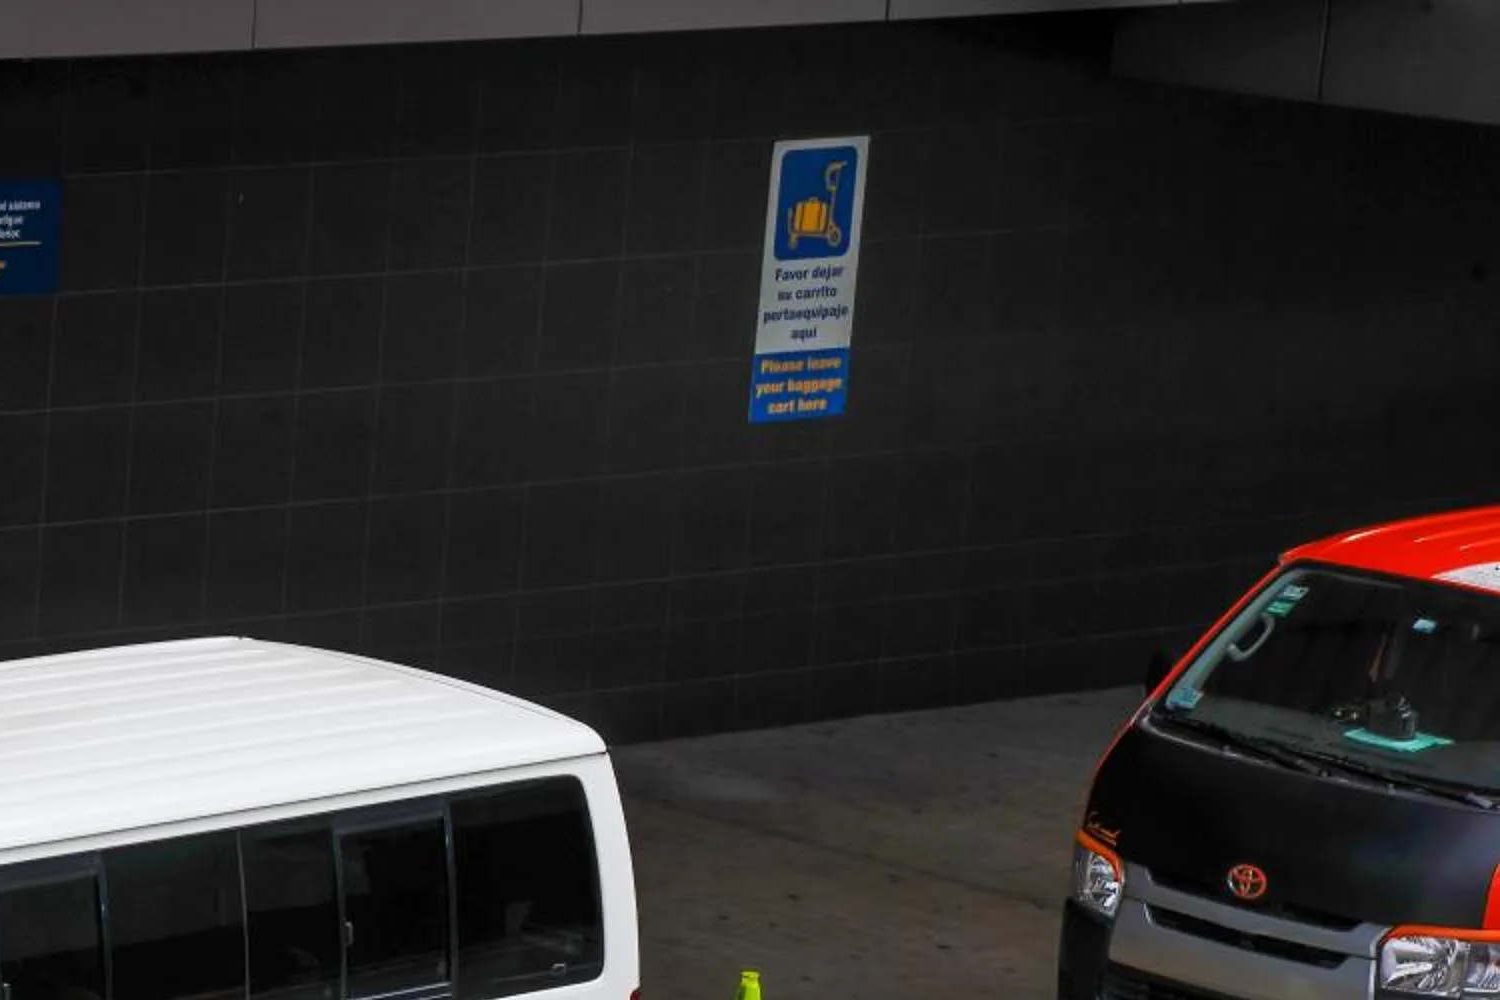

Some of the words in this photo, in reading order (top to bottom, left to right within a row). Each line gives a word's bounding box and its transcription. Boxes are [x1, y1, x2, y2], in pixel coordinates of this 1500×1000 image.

[774, 267, 809, 282] Favor
[811, 264, 844, 281] dejar
[795, 284, 837, 301] carrito
[763, 304, 848, 323] portaequipaje
[761, 358, 804, 374] Please
[807, 356, 842, 371] leave
[755, 381, 784, 398] your
[786, 378, 842, 396] baggage
[767, 399, 795, 415] cart
[797, 398, 828, 412] here
